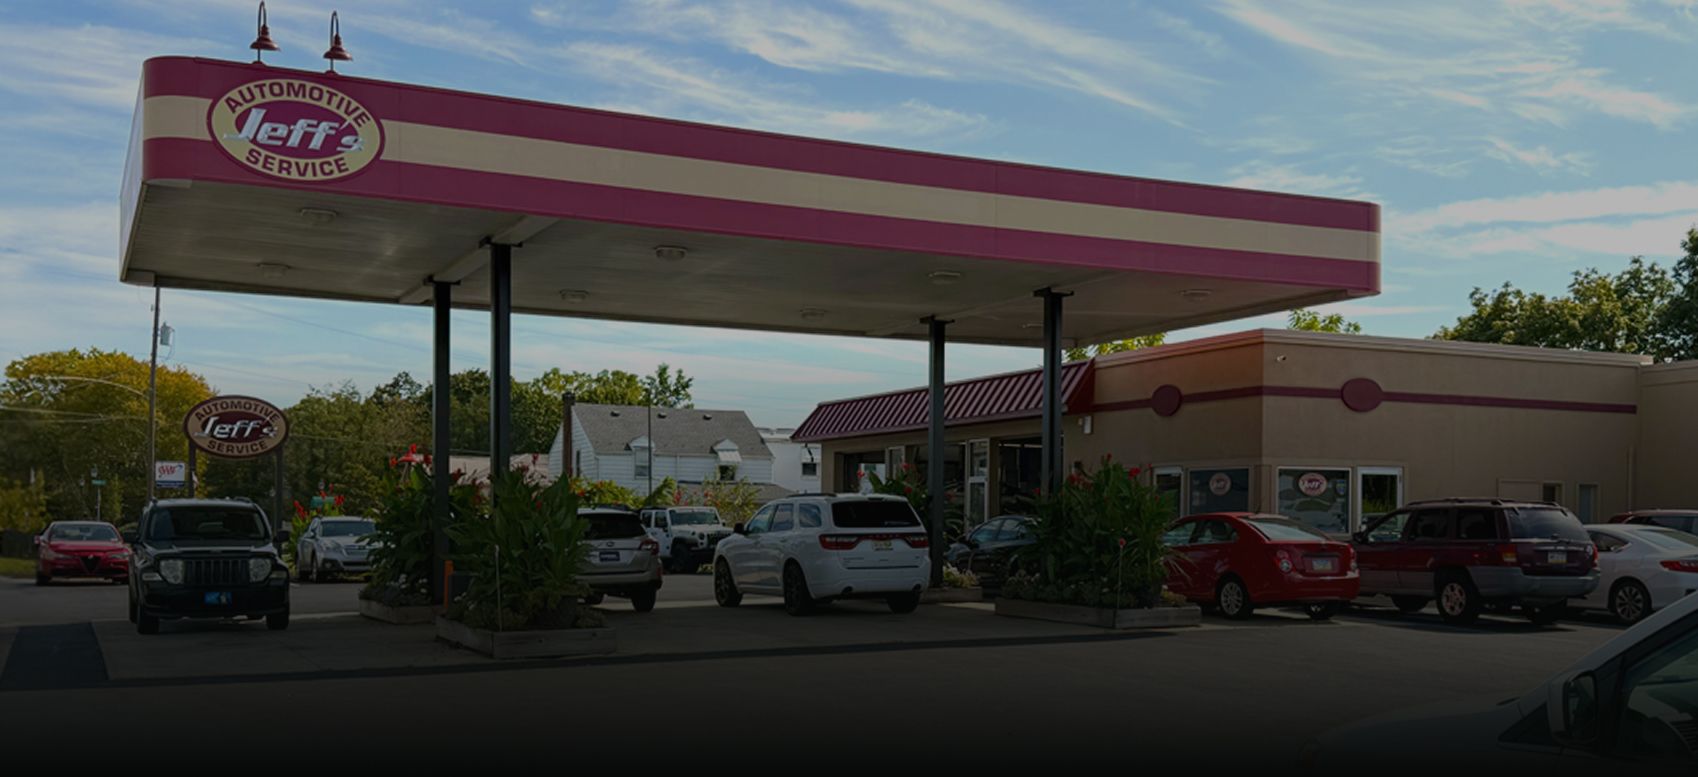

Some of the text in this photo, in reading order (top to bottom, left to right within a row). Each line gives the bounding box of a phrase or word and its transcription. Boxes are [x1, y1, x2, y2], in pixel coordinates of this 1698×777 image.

[224, 82, 371, 128] AUTOMOTIVE
[223, 108, 365, 153] Jeff's
[245, 148, 349, 177] SERVICE
[195, 401, 280, 422] AUTOMOTIVE
[208, 440, 268, 454] SERVICE
